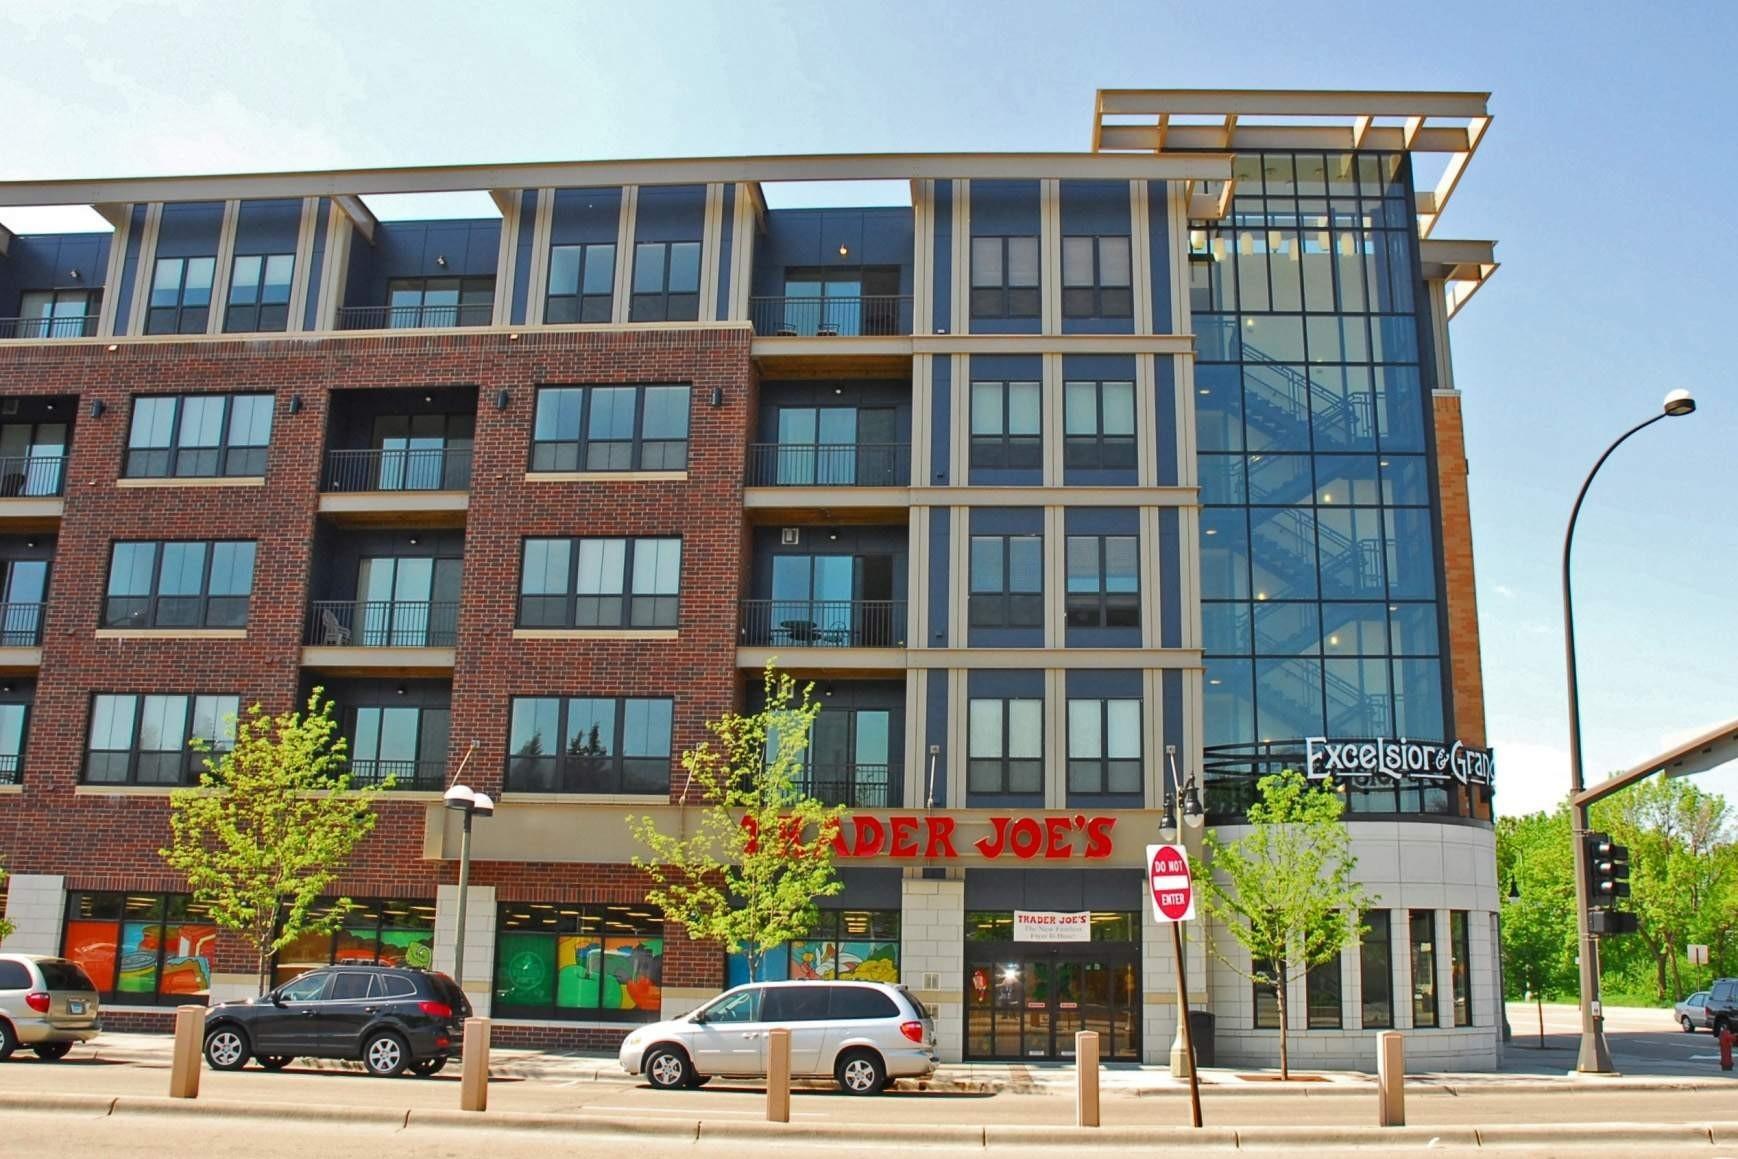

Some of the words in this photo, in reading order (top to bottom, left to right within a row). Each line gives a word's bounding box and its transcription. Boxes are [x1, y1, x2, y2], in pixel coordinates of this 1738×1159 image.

[1435, 748, 1449, 770] &
[972, 814, 1117, 859] JOE'S
[1154, 860, 1167, 873] DO
[1168, 860, 1184, 873] NOT
[1161, 893, 1185, 906] ENTER
[1018, 914, 1056, 924] TRADER
[1059, 915, 1087, 924] JOE'S
